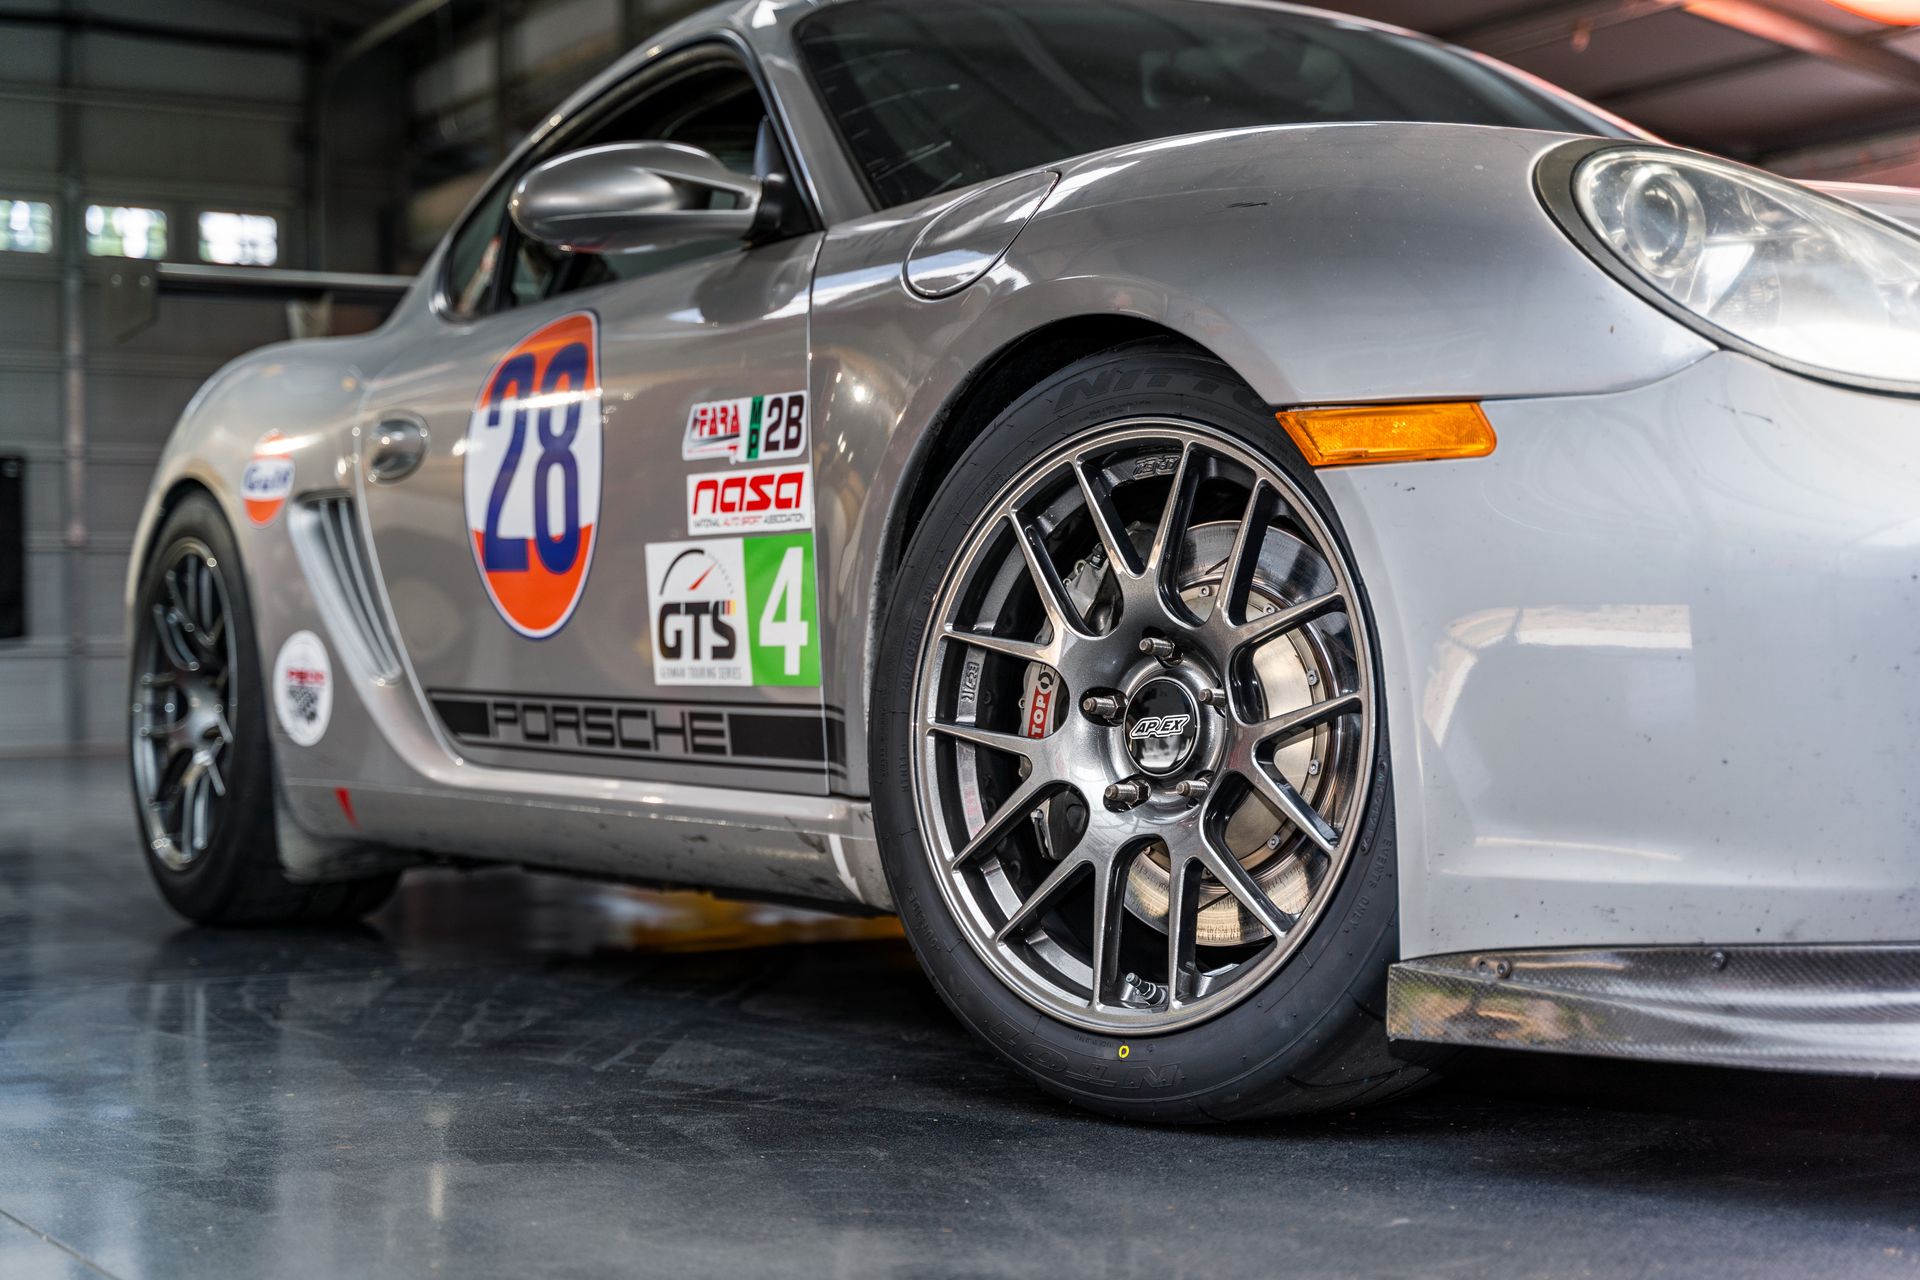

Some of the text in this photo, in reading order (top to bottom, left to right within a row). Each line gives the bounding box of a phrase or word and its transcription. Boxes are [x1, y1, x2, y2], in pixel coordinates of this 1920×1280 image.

[764, 394, 805, 453] 2B
[484, 342, 589, 575] 28
[692, 471, 805, 515] nasa
[658, 546, 809, 676] GTS 4
[494, 701, 728, 756] PORSCHE
[1031, 694, 1046, 737] TOP
[1133, 717, 1186, 736] APEX
